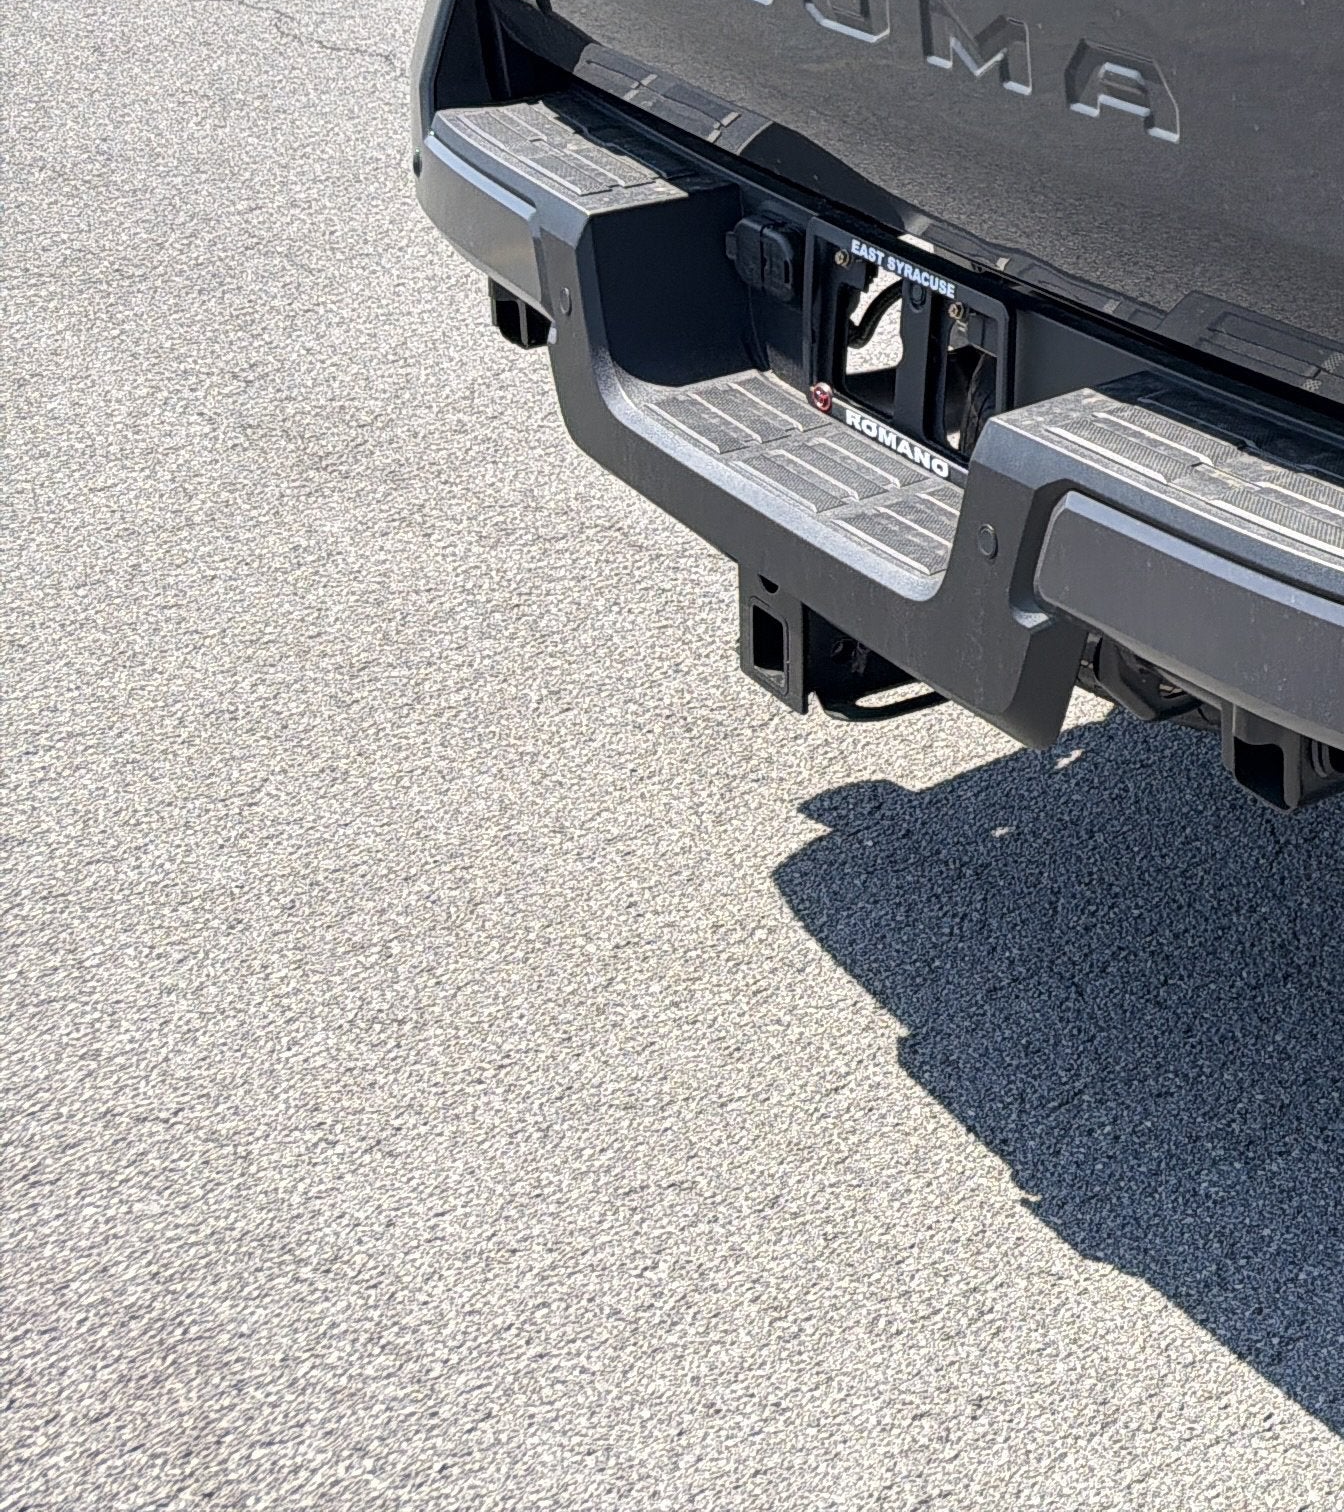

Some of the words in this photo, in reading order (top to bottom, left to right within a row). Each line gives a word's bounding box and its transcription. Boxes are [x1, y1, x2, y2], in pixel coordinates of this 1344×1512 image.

[850, 238, 886, 270] EAST
[886, 255, 956, 299] SYRACUSE
[844, 408, 951, 478] ROMANO
